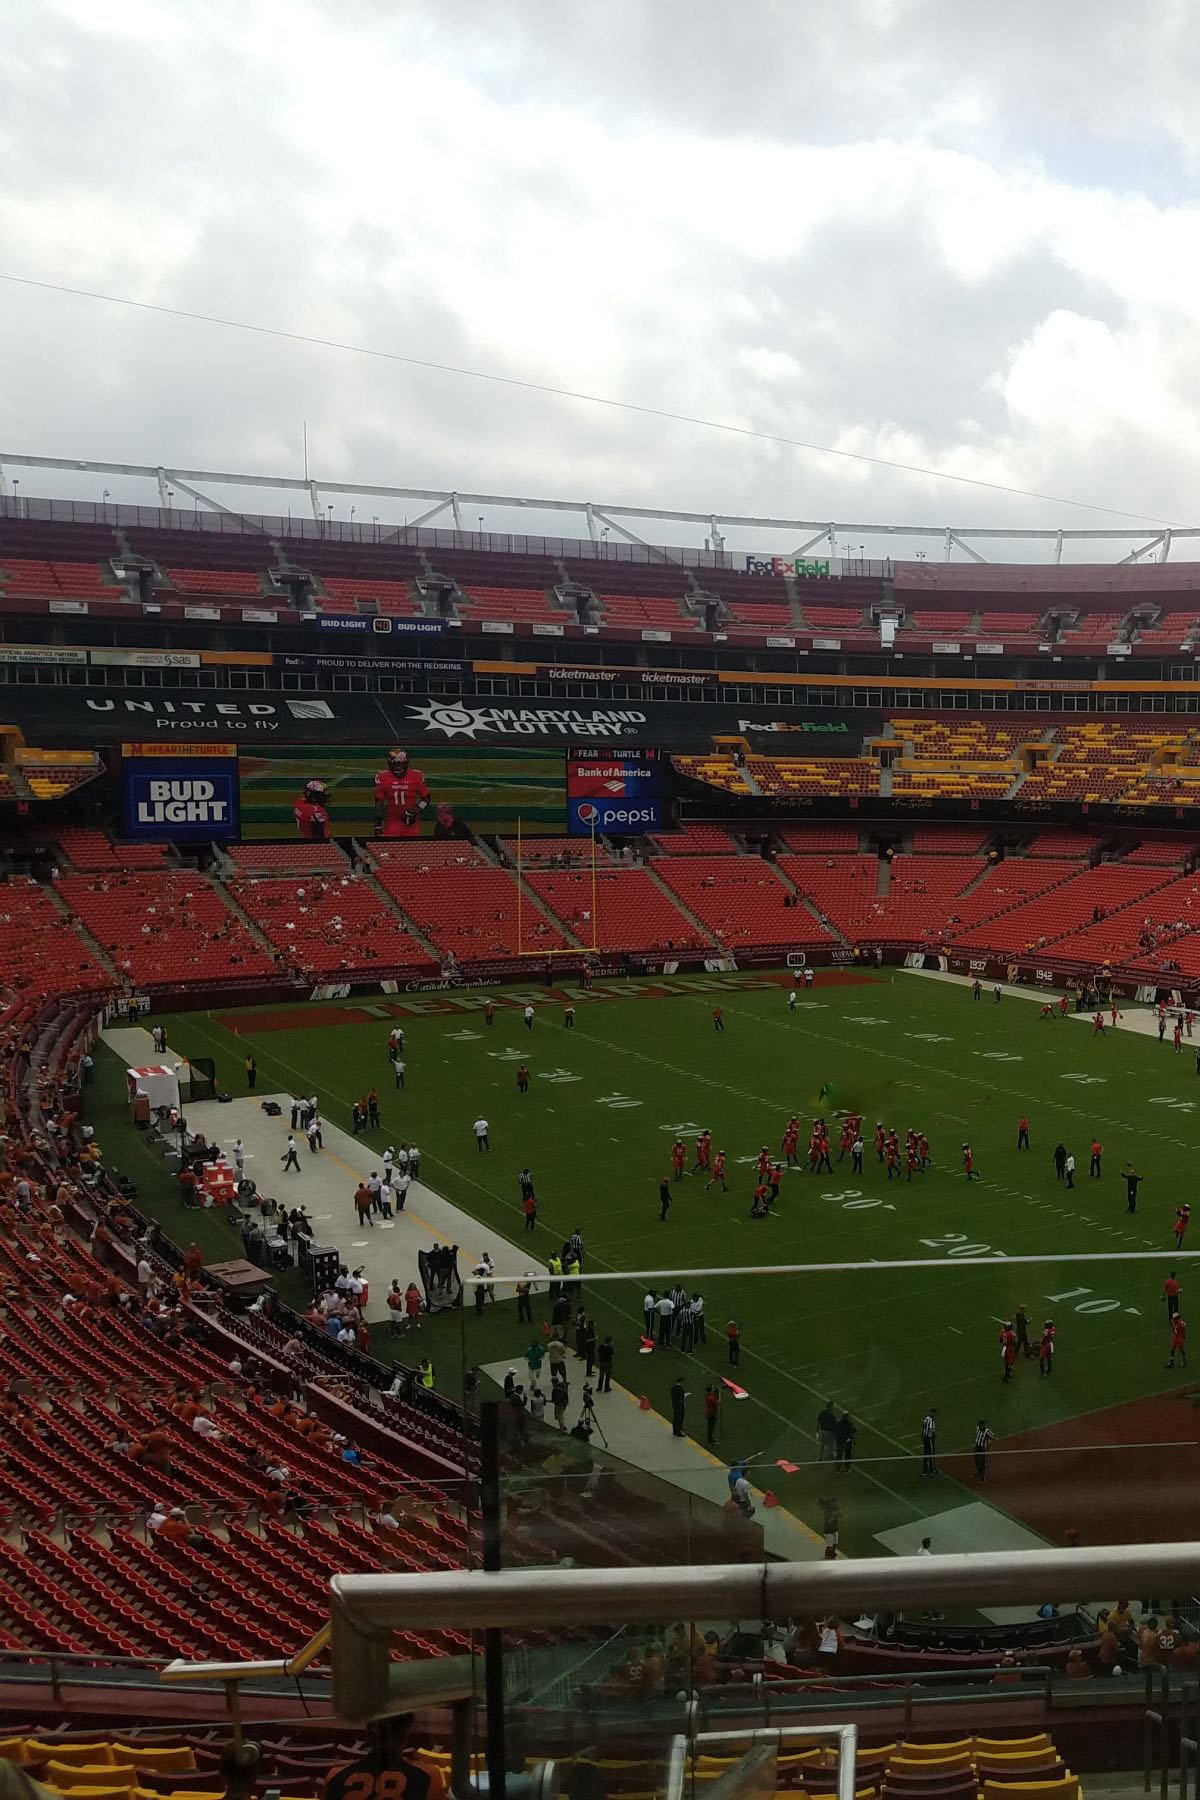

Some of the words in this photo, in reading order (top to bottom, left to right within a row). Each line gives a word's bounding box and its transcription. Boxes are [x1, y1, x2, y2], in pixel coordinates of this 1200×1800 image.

[746, 556, 829, 576] FedExField
[321, 620, 340, 628] BUD
[340, 620, 367, 629] LIGHT
[375, 621, 389, 631] 40
[398, 623, 417, 632] BUD
[418, 624, 442, 633] LIGHT
[172, 656, 192, 664] sas
[316, 658, 344, 667] PROUD
[345, 660, 356, 668] TO
[358, 660, 390, 668] DELIVER
[391, 660, 406, 669] FOR
[548, 668, 618, 681] ticketmaster
[641, 672, 707, 684] ticketmaster
[85, 699, 277, 715] UNITED
[489, 708, 647, 724] MARYLAND
[156, 718, 218, 729] Proud
[226, 720, 246, 729] to
[254, 720, 280, 730] fly
[495, 720, 625, 737] LOTTERY
[738, 719, 848, 733] FedExField
[578, 766, 601, 778] Bank
[602, 767, 613, 778] of
[614, 768, 652, 778] America
[149, 780, 215, 801] BUD
[393, 790, 406, 806] 11
[138, 800, 227, 822] LIGHT
[604, 806, 655, 824] pepsi
[969, 960, 987, 970] 1937
[1036, 970, 1054, 980] 1942
[344, 977, 786, 1018] TERRAPINS
[820, 1190, 885, 1210] 30
[918, 1232, 993, 1258] 20
[1044, 1286, 1122, 1315] 10
[1160, 1635, 1174, 1650] 32
[342, 1770, 408, 1800] 28
